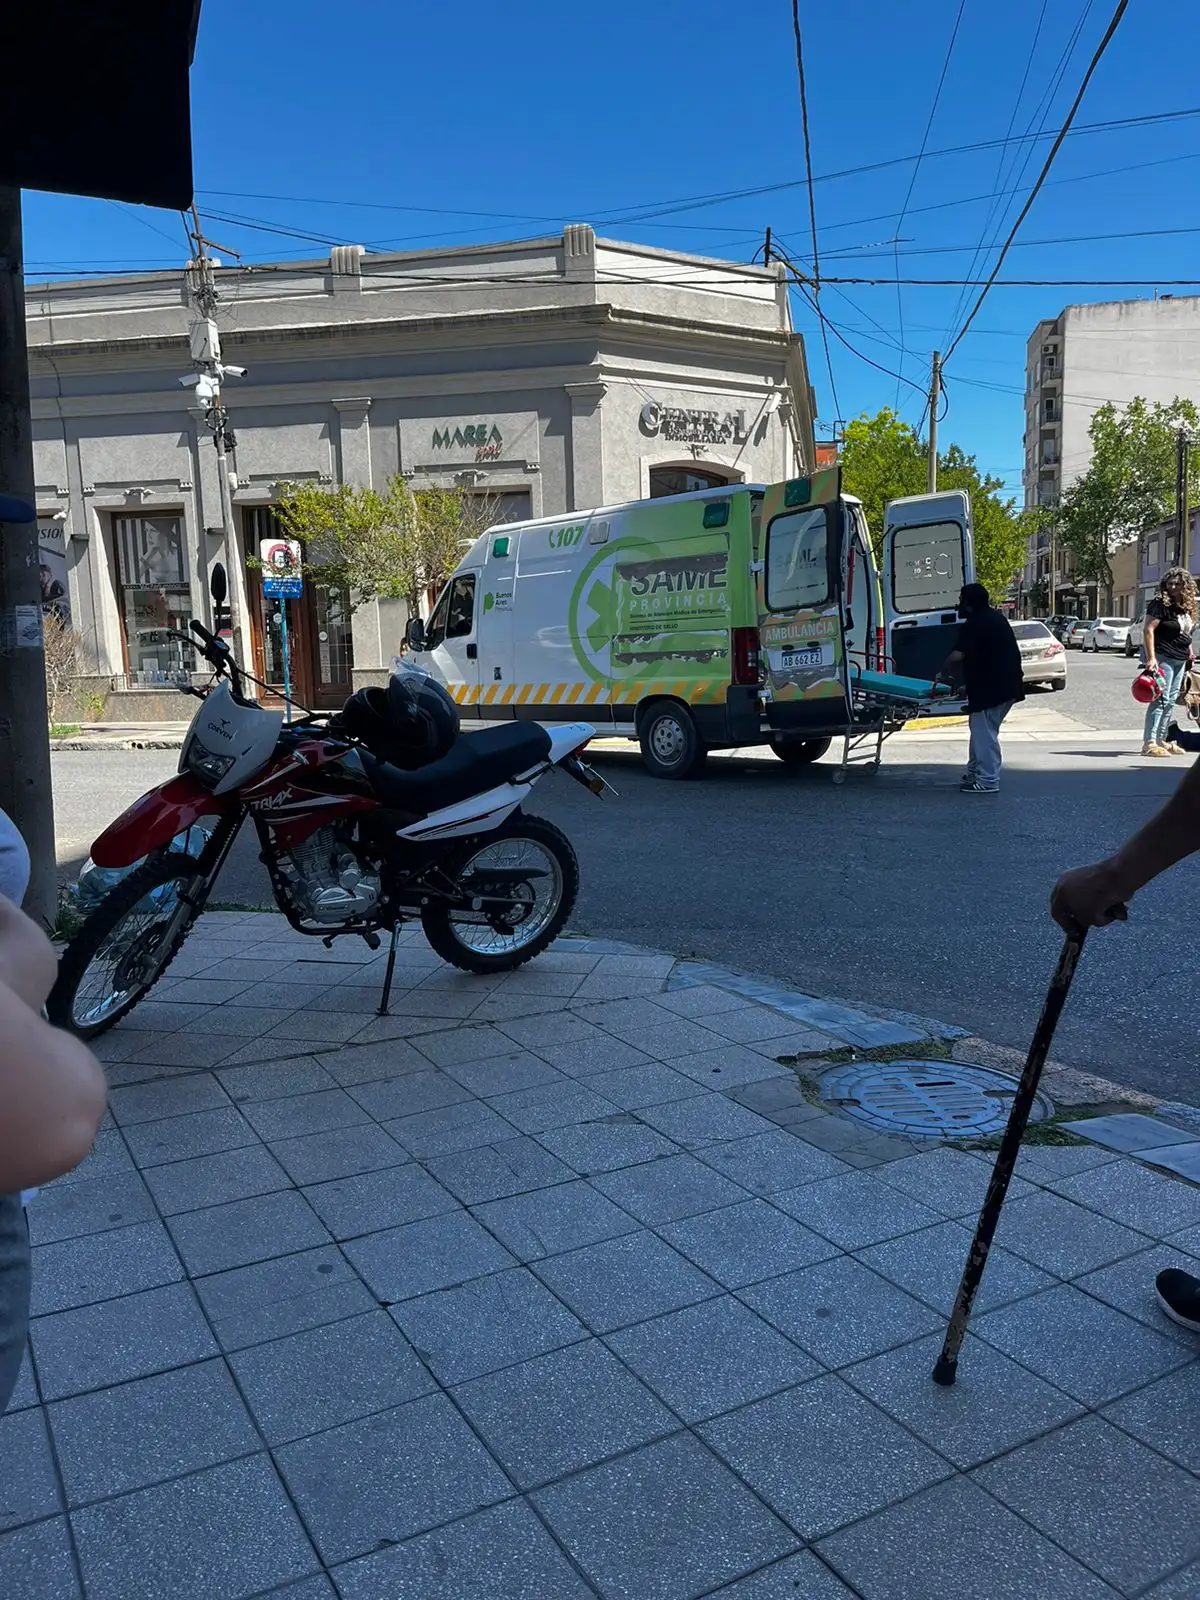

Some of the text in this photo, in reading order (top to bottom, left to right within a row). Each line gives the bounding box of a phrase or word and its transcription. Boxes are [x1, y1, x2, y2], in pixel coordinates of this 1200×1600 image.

[640, 401, 752, 441] CENTRAL
[432, 424, 503, 449] MAREA
[557, 526, 585, 548] 107
[631, 568, 727, 596] SAME
[629, 592, 727, 611] PROVINCIA
[765, 621, 835, 641] AMBULANCIA
[783, 653, 820, 667] AB 662 EZ
[250, 788, 293, 810] TRIAX
